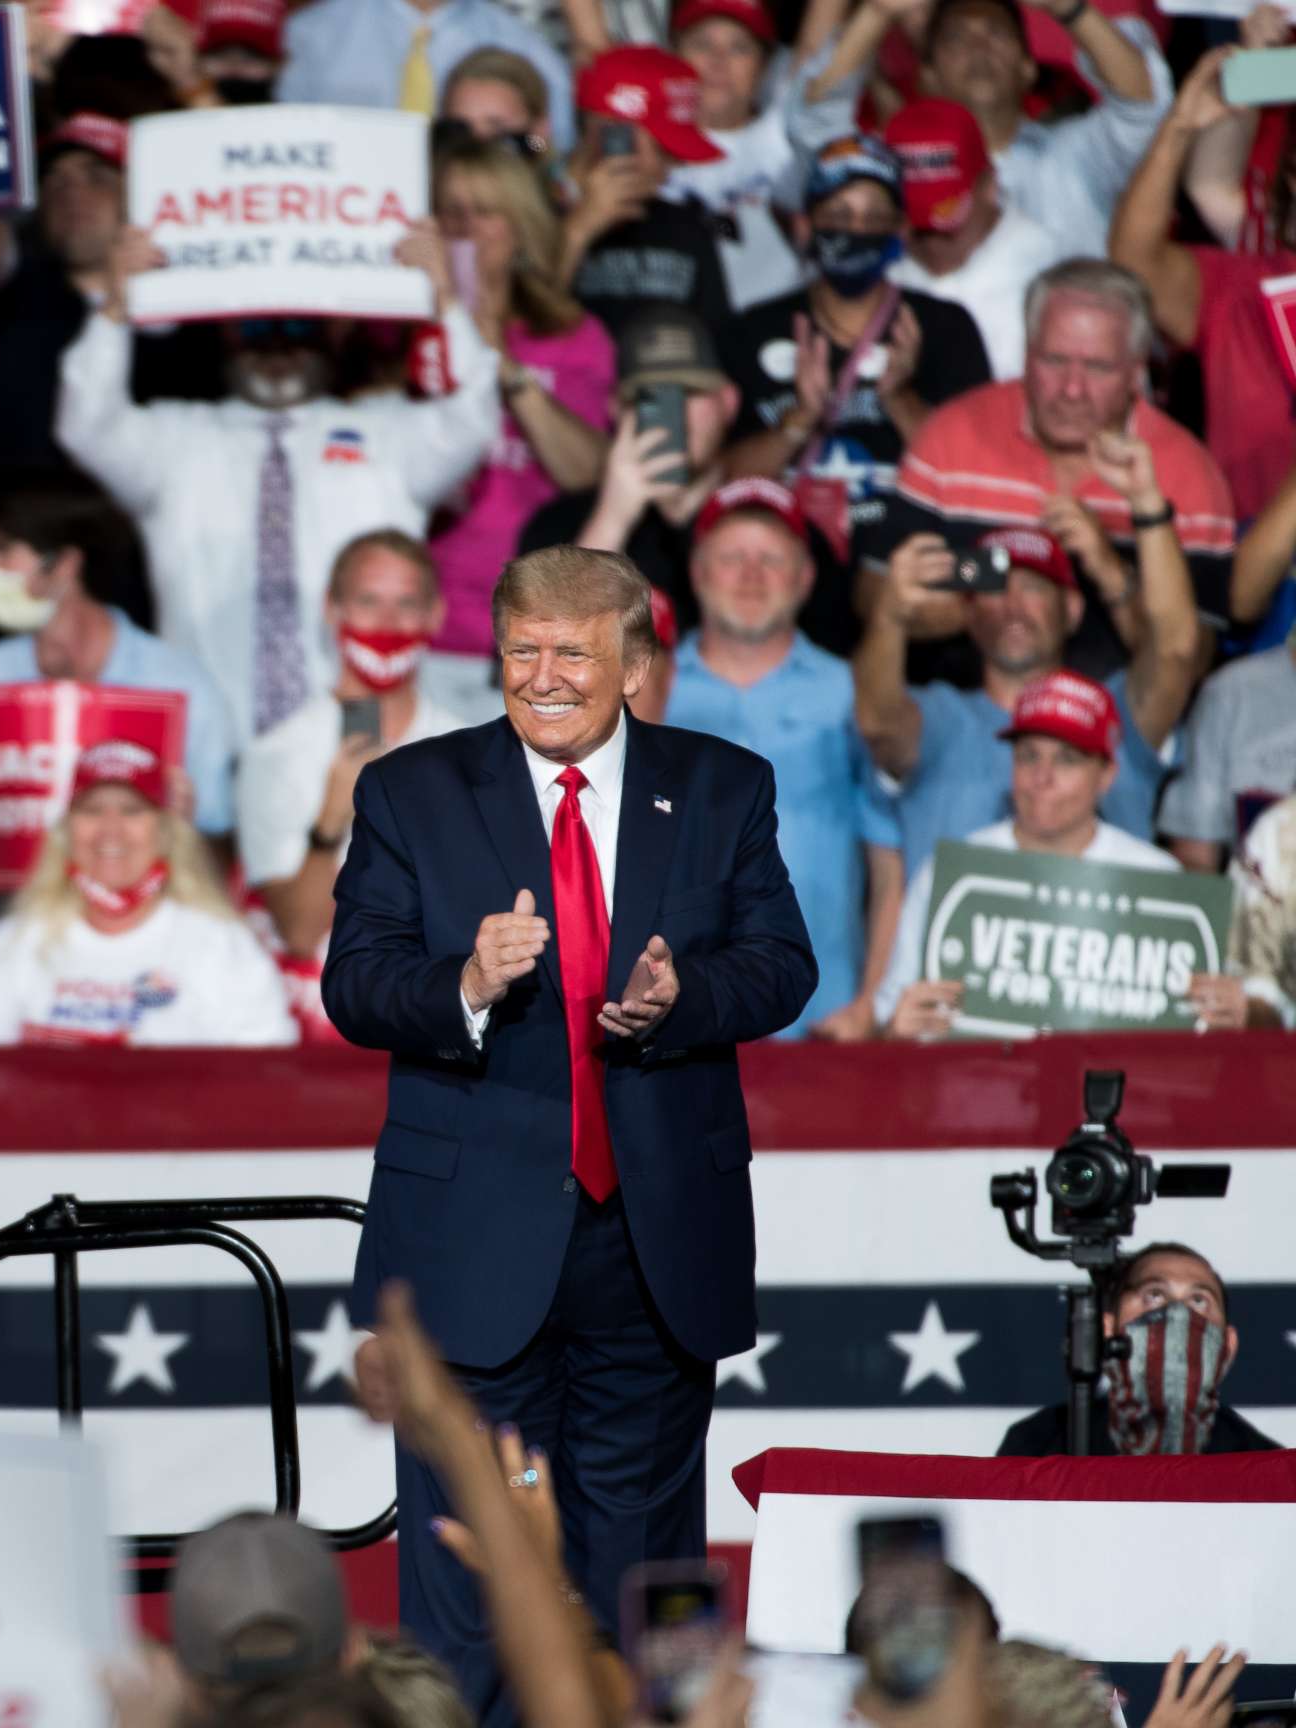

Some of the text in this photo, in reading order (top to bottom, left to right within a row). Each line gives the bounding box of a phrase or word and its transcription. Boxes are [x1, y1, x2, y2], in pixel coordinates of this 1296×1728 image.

[222, 142, 337, 169] MAKE
[152, 183, 410, 229] AMERICA
[292, 236, 390, 266] AGAI
[971, 914, 1196, 996] VETERANS
[54, 977, 135, 1003] FOU
[988, 966, 1168, 1020] FOR TRUMP
